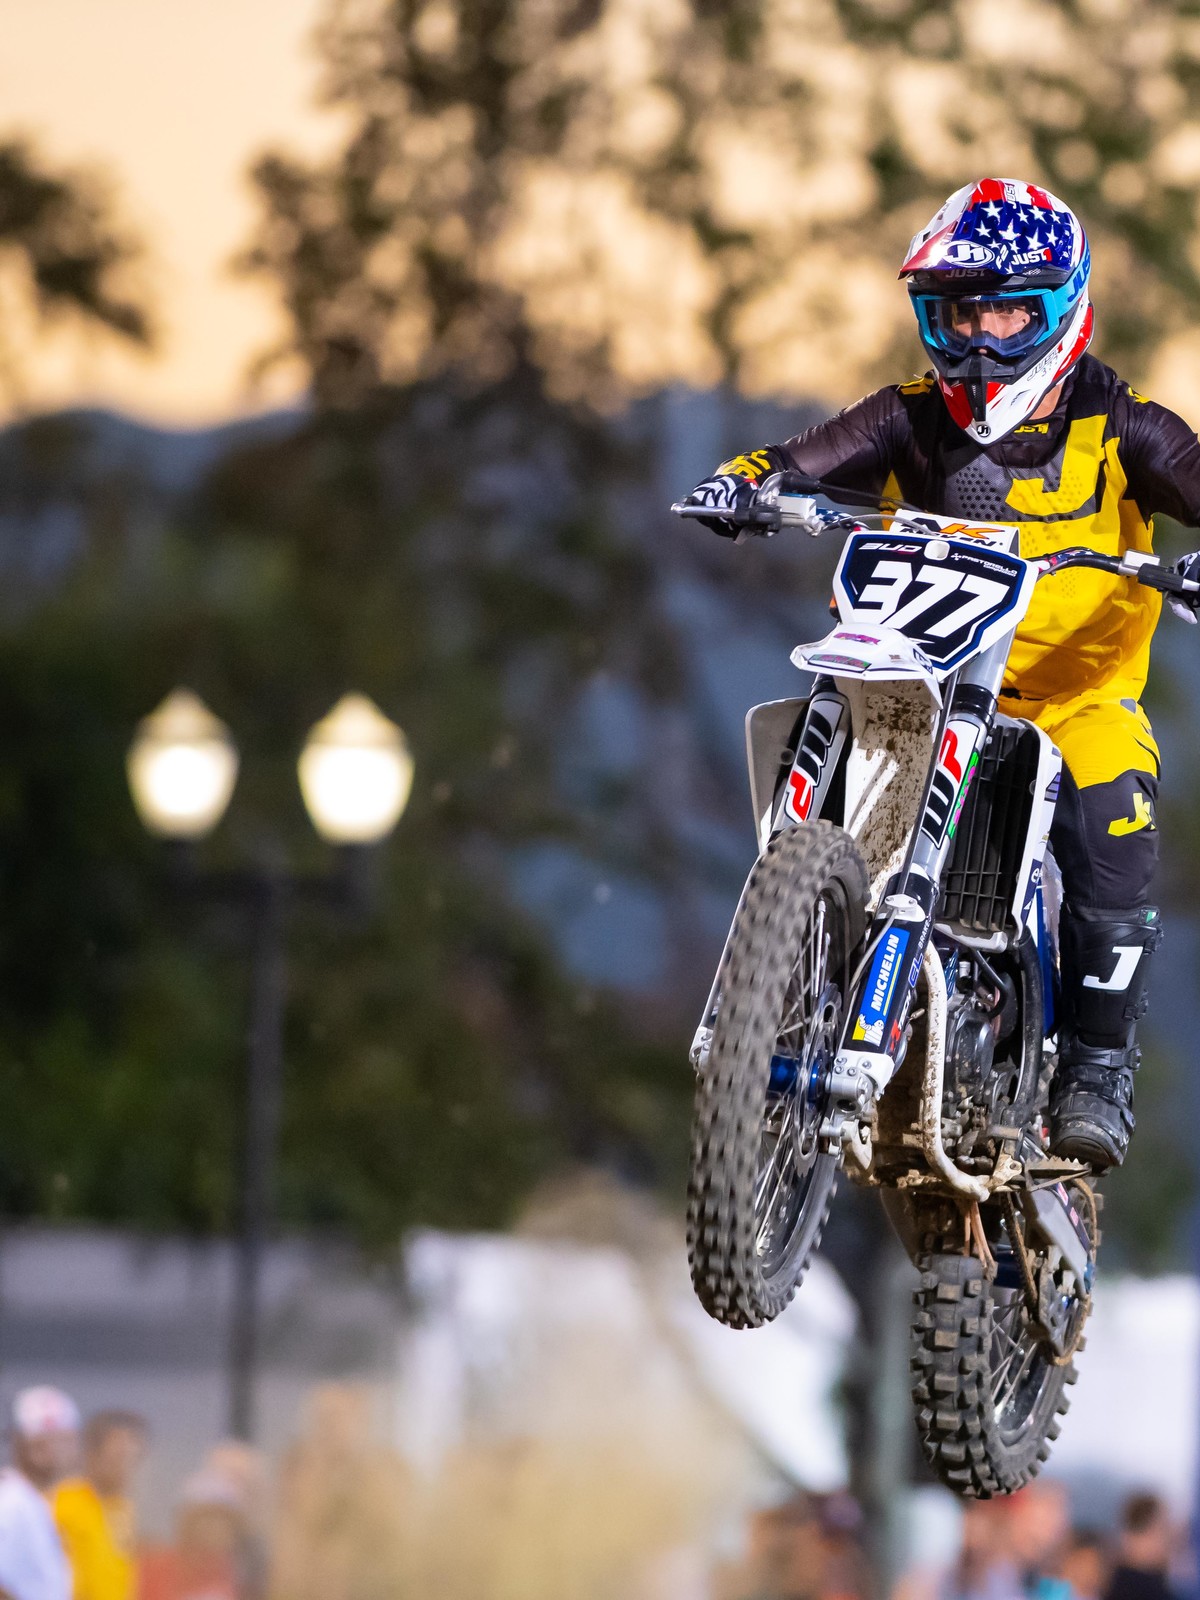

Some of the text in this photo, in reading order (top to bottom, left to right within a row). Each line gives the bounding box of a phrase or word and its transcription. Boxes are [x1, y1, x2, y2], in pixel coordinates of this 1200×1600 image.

[945, 268, 985, 278] JUST
[1011, 247, 1052, 266] JUST1
[961, 555, 1018, 575] PASTORELLO
[851, 560, 1011, 638] 377
[870, 933, 900, 1012] MICHELIN
[1083, 945, 1145, 991] J
